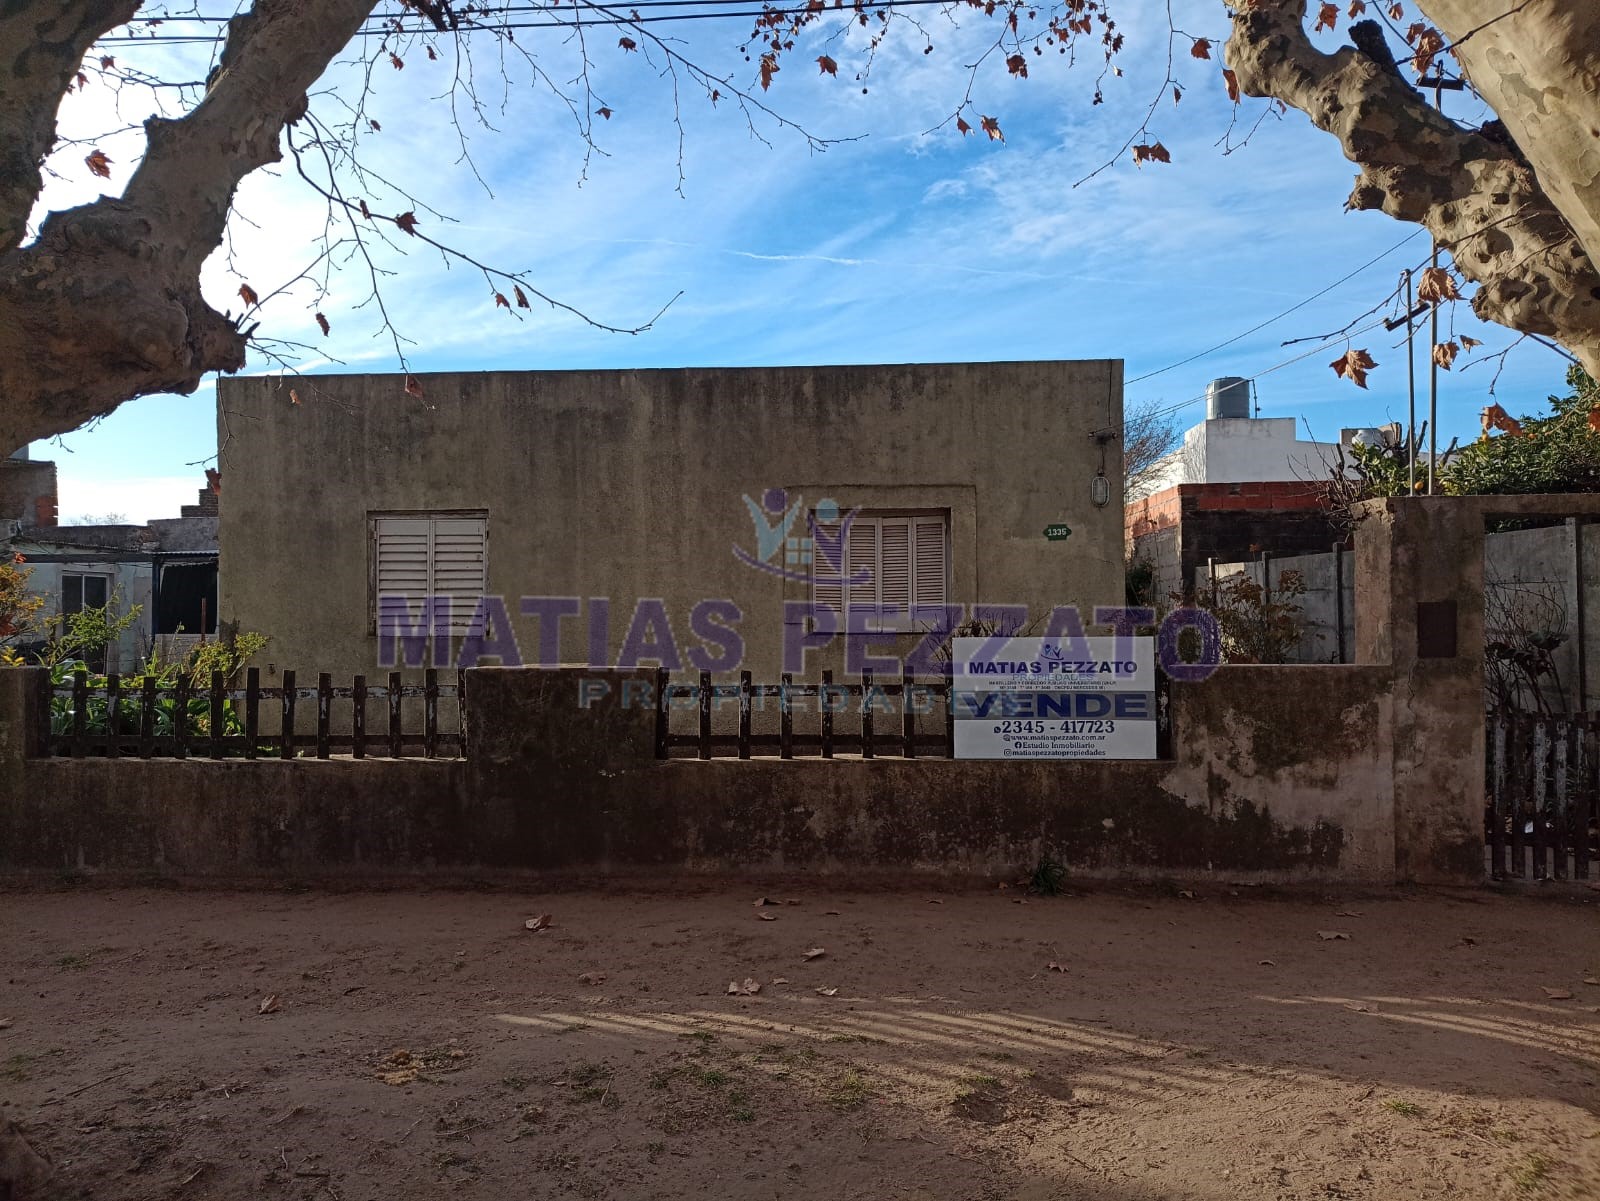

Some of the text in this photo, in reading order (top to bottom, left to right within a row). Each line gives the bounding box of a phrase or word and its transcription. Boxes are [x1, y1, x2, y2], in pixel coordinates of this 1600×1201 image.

[1047, 528, 1067, 536] 1335
[969, 661, 1138, 674] MATIAS PEZZATO
[1012, 673, 1094, 681] PROPIEDADES
[961, 693, 1148, 718] VENDE
[1002, 721, 1045, 734] 2345
[1060, 721, 1115, 734] 417723
[1011, 734, 1106, 743] www.matiaspezzato.com.ar
